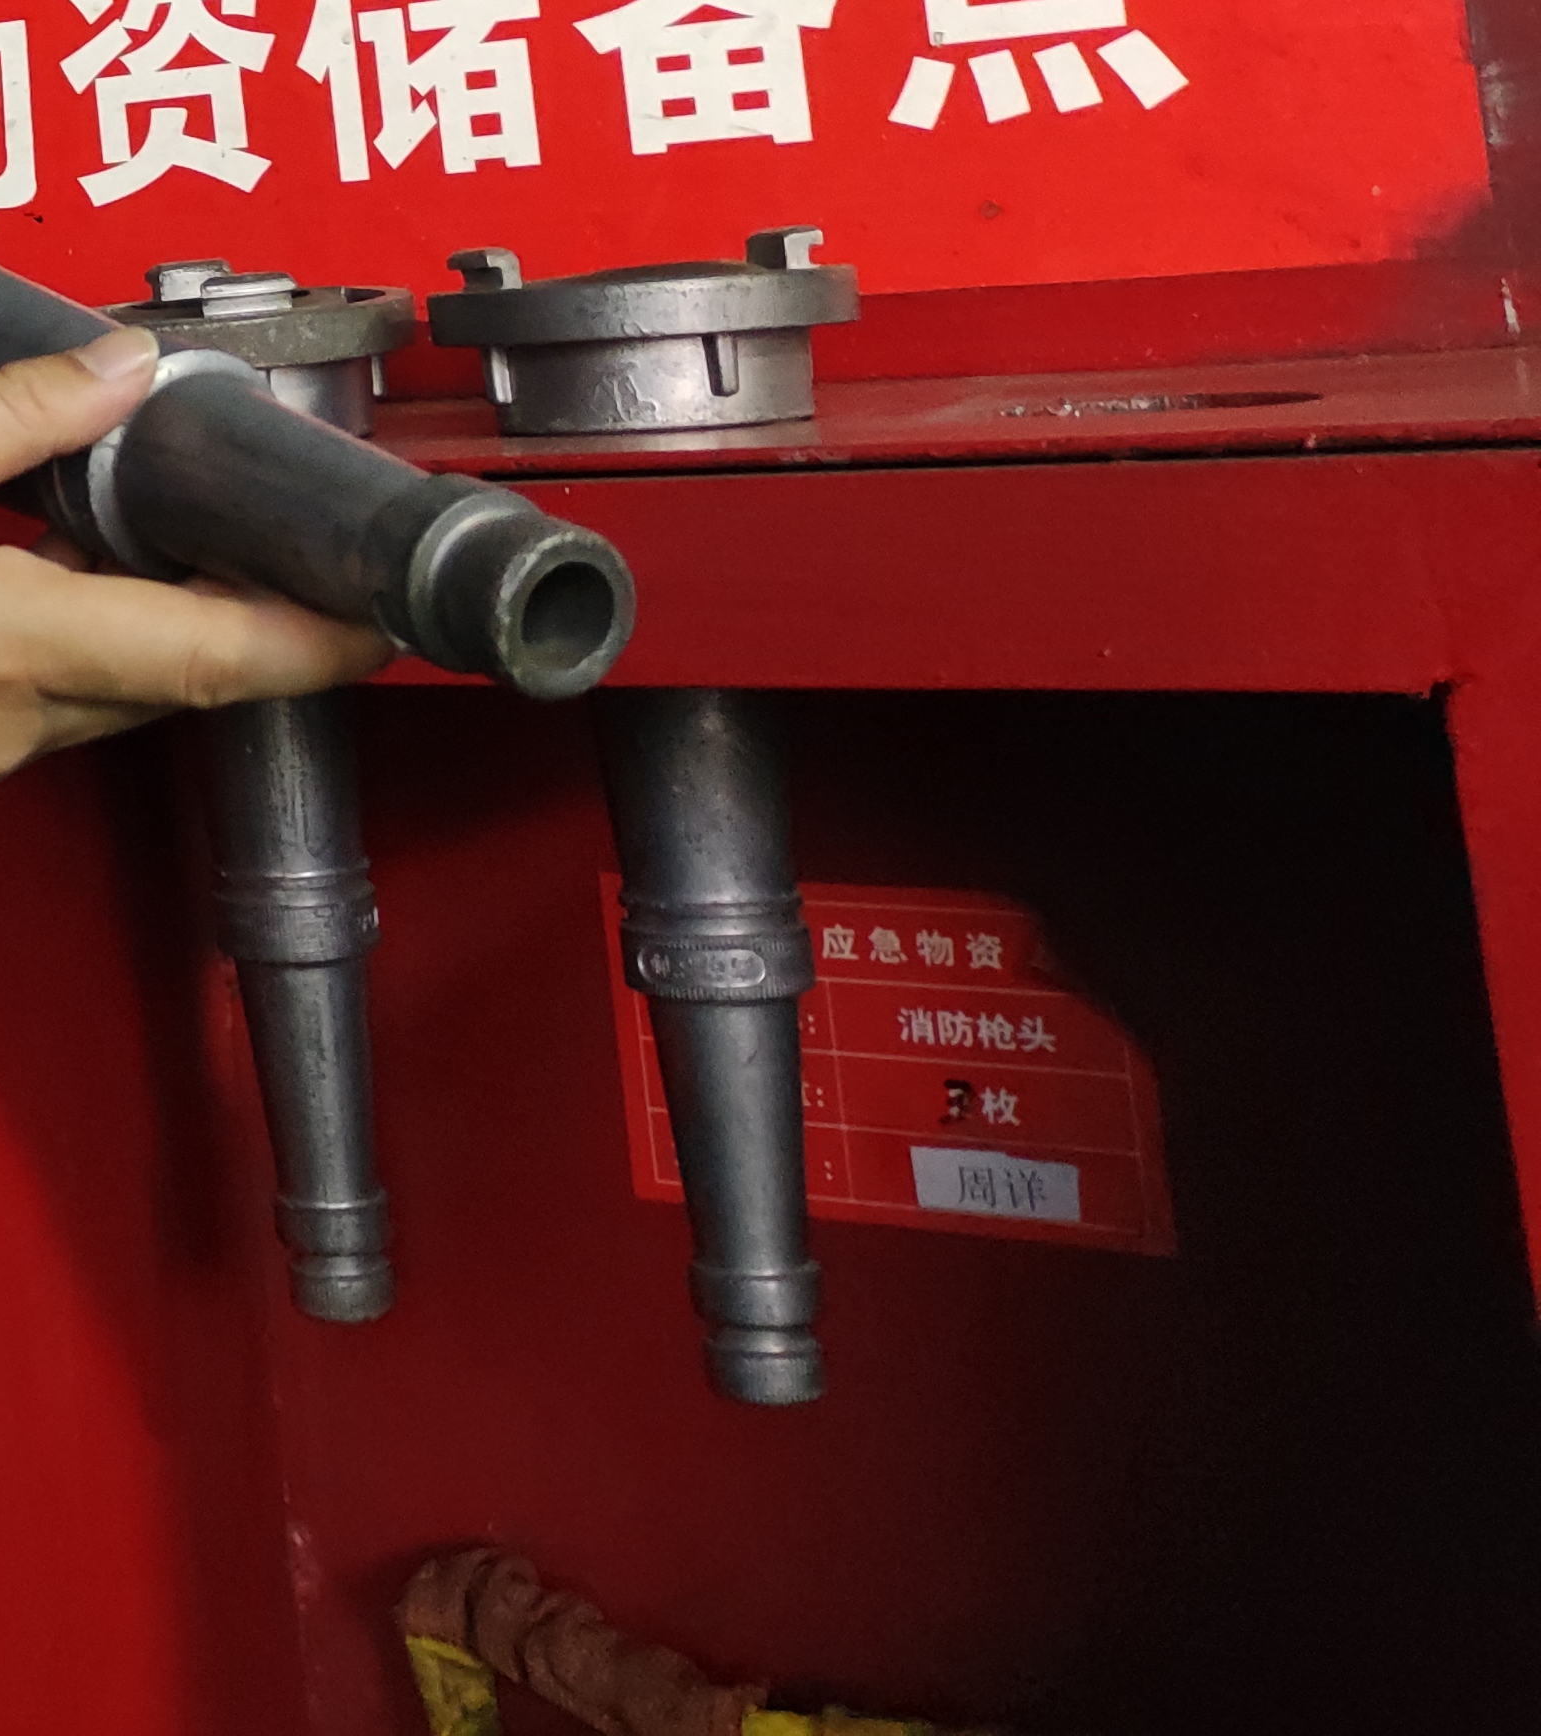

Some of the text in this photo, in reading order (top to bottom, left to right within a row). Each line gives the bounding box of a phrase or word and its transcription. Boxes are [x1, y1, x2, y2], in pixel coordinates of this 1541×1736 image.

[821, 923, 1004, 970] 应急物资
[897, 1006, 1057, 1053] 消防枪头
